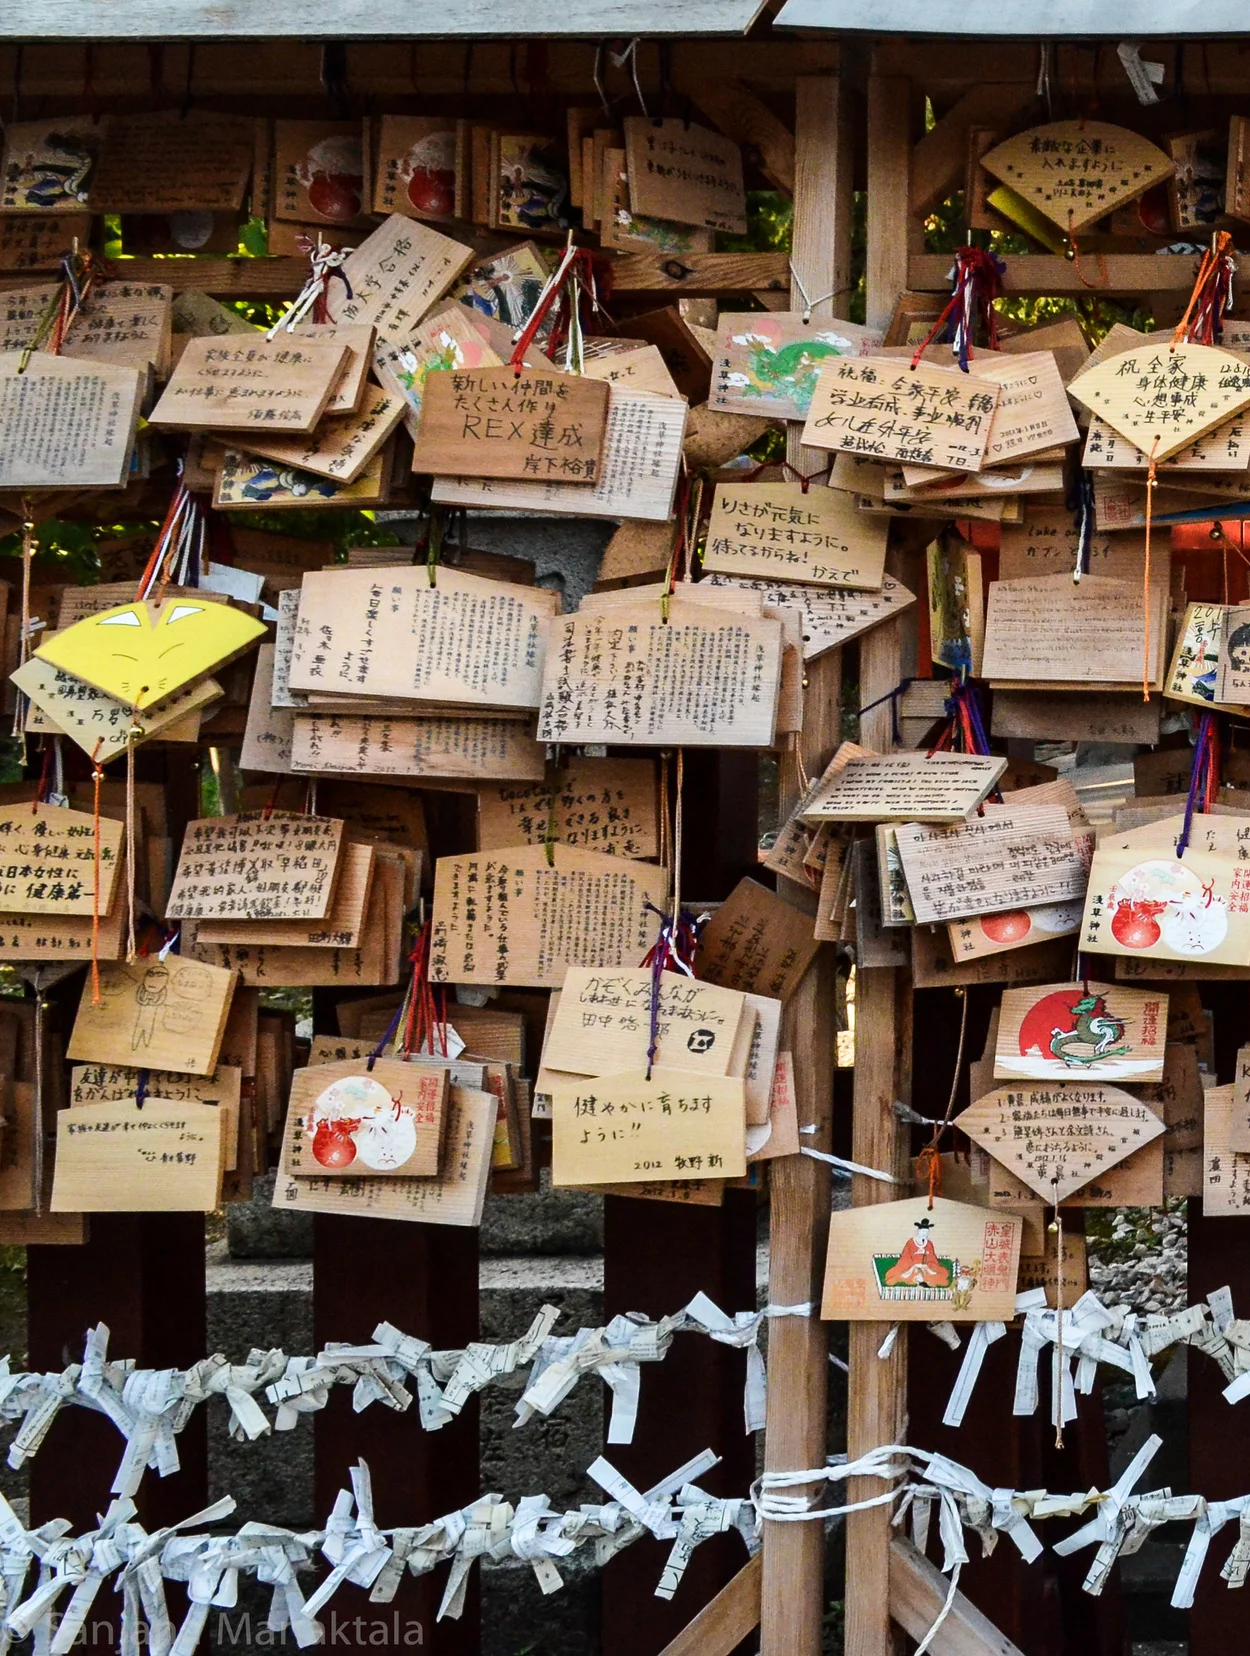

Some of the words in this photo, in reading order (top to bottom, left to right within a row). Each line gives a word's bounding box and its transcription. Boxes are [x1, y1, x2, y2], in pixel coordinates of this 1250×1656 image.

[450, 373, 571, 400] 新しい仲間を
[715, 358, 731, 404] 浅草神社
[1136, 372, 1209, 393] 身体健康
[454, 396, 557, 420] たくさん作り
[1132, 391, 1198, 409] 心想事成
[523, 453, 597, 482] 岸下裕貴
[721, 496, 820, 526] りさが元気に
[734, 521, 849, 552] なりますように。
[711, 538, 809, 564] 待ってるからね!
[811, 565, 860, 583] かえで
[1171, 647, 1192, 693] 浅草神社
[26, 881, 96, 901] 健康第一
[1228, 867, 1243, 912] 家内安全
[639, 890, 653, 949] 浅神社縁起
[1087, 895, 1103, 943] 浅草神社
[582, 1012, 612, 1029] 田中
[573, 1090, 714, 1119] 健やかに育ちます
[580, 1121, 642, 1144] ように!!
[633, 1159, 663, 1171] 2012
[674, 1156, 703, 1171] 牧野
